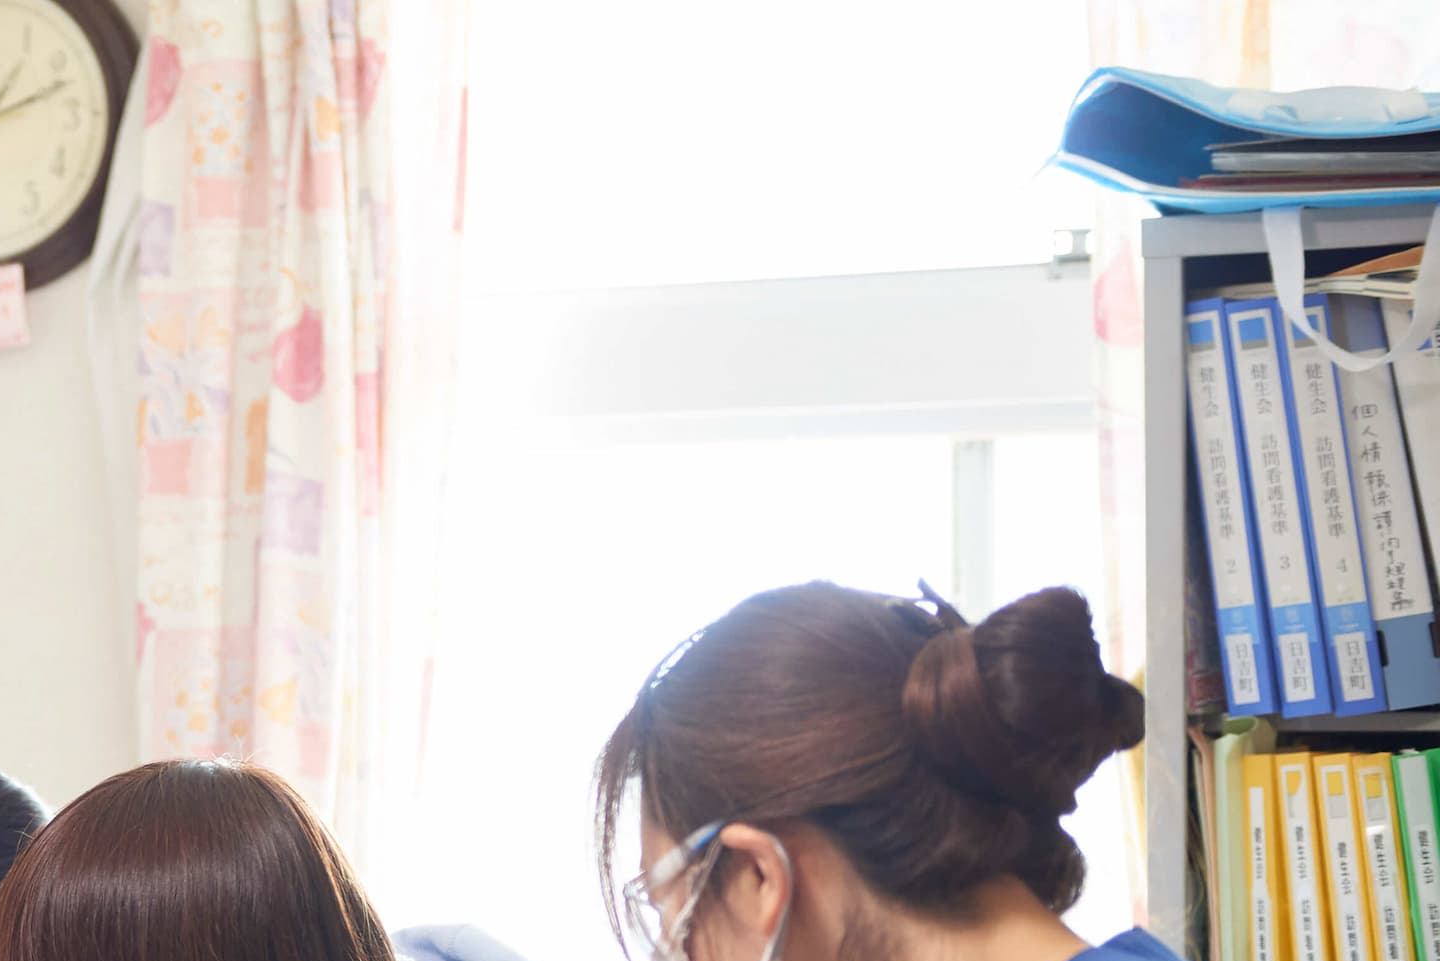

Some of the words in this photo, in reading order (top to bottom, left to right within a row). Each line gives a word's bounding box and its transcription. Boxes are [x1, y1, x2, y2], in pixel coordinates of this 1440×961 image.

[1199, 365, 1220, 418] 健生会
[1225, 558, 1239, 575] 2
[1250, 363, 1273, 416] 健生会
[1278, 555, 1292, 571] 3
[1305, 363, 1328, 416] 健生会
[1336, 557, 1348, 574] 4
[1231, 643, 1254, 695] 日吉町
[1289, 641, 1309, 692] 日吉町
[1345, 641, 1368, 692] 日吉町
